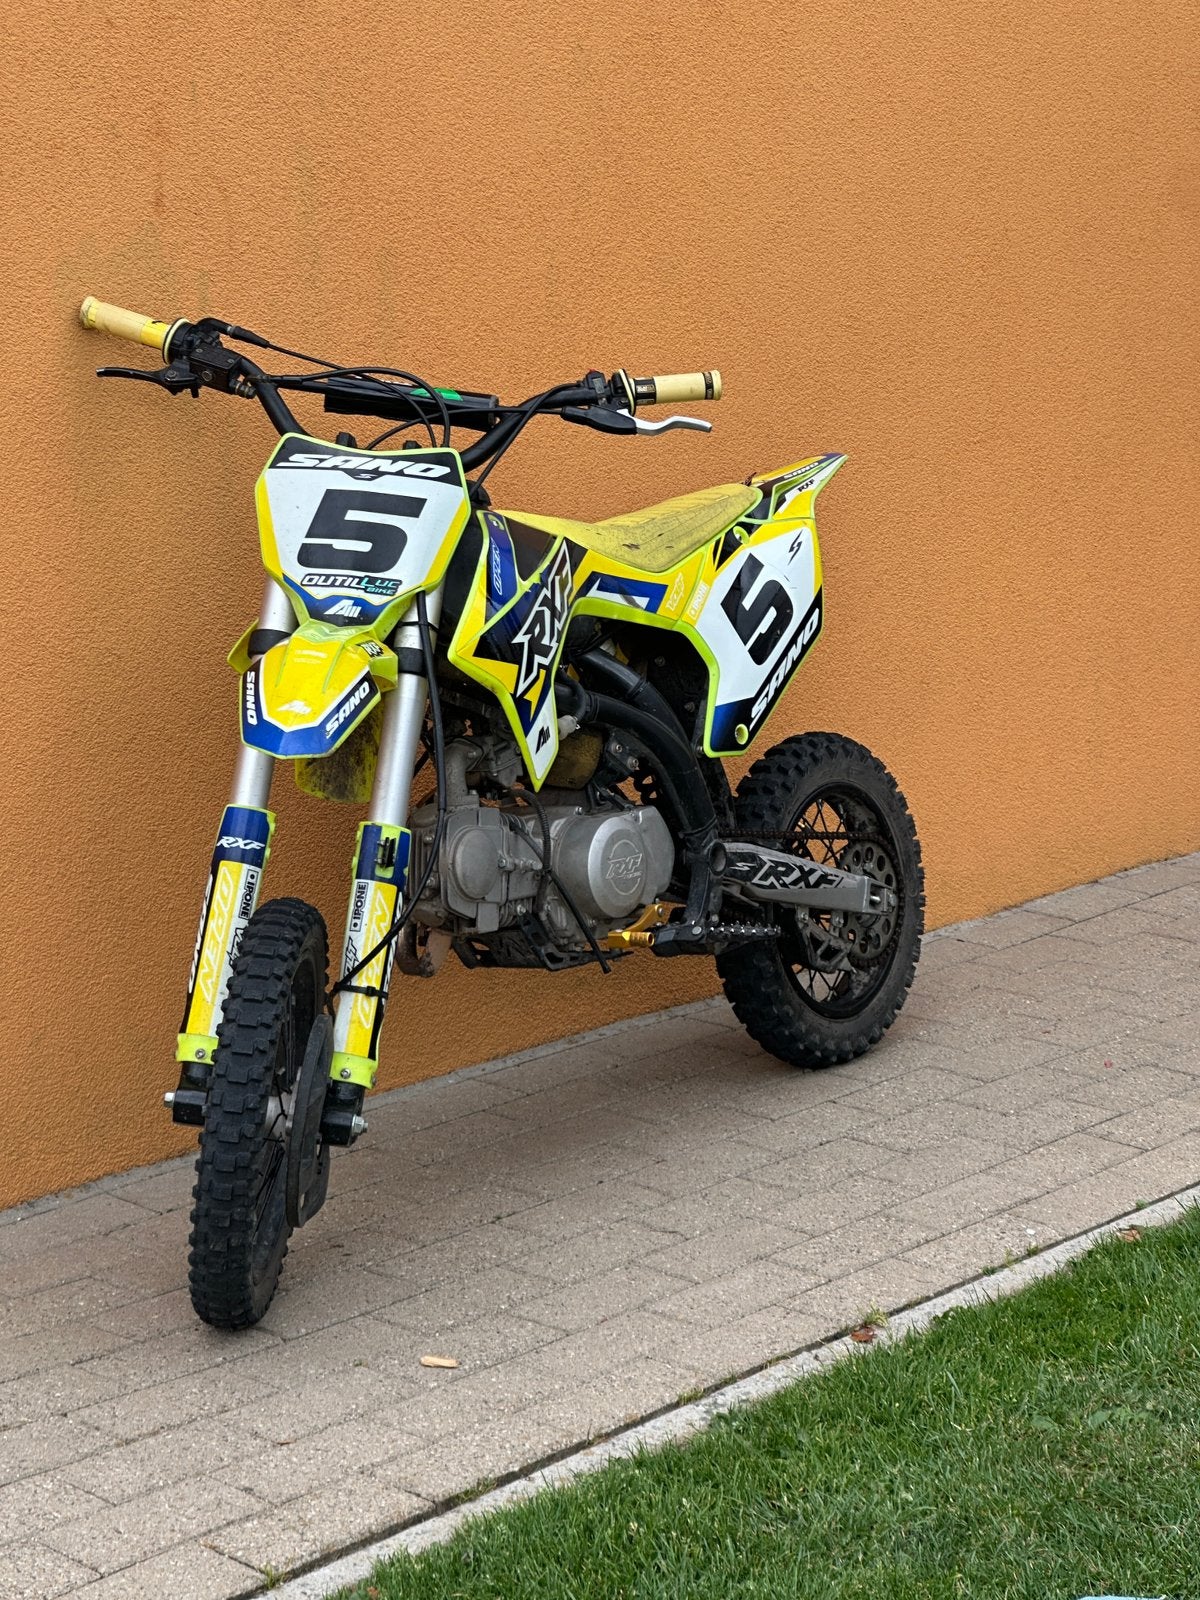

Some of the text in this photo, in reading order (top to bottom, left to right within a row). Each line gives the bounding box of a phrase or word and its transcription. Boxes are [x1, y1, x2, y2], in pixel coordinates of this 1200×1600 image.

[276, 453, 451, 478] SANO
[297, 488, 428, 574] 5
[720, 552, 794, 666] 5
[749, 607, 820, 731] SANO
[246, 671, 258, 726] SANO
[325, 681, 370, 739] SANO
[216, 836, 265, 850] RXF
[751, 855, 843, 890] RXF
[240, 881, 255, 920] IPONE
[353, 884, 367, 920] IPONE
